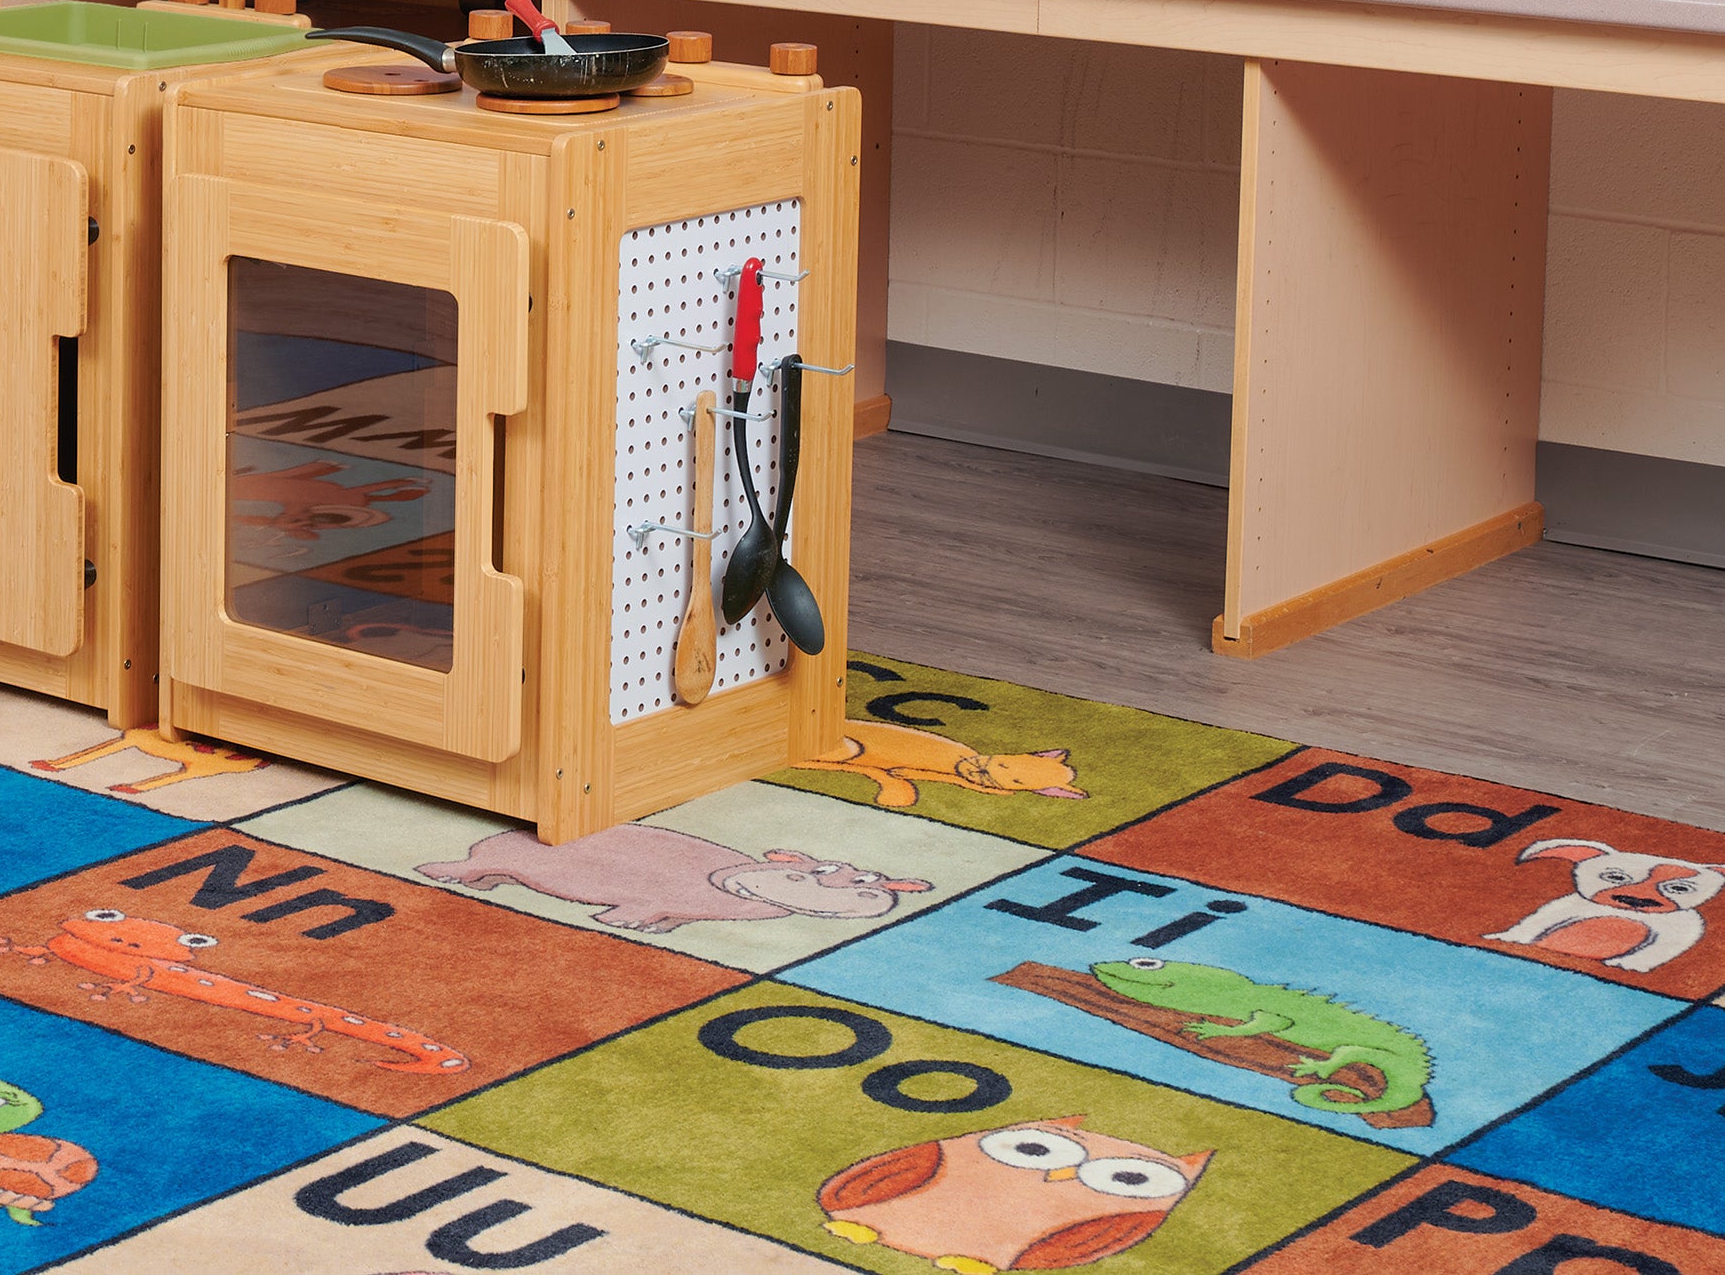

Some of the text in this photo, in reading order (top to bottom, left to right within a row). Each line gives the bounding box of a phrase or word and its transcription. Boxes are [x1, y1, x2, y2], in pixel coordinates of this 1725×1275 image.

[1249, 761, 1564, 850] Dd
[118, 844, 396, 941] Nn
[983, 866, 1249, 951] Ii
[698, 1005, 1013, 1115] Oo
[291, 1141, 608, 1270] Uu
